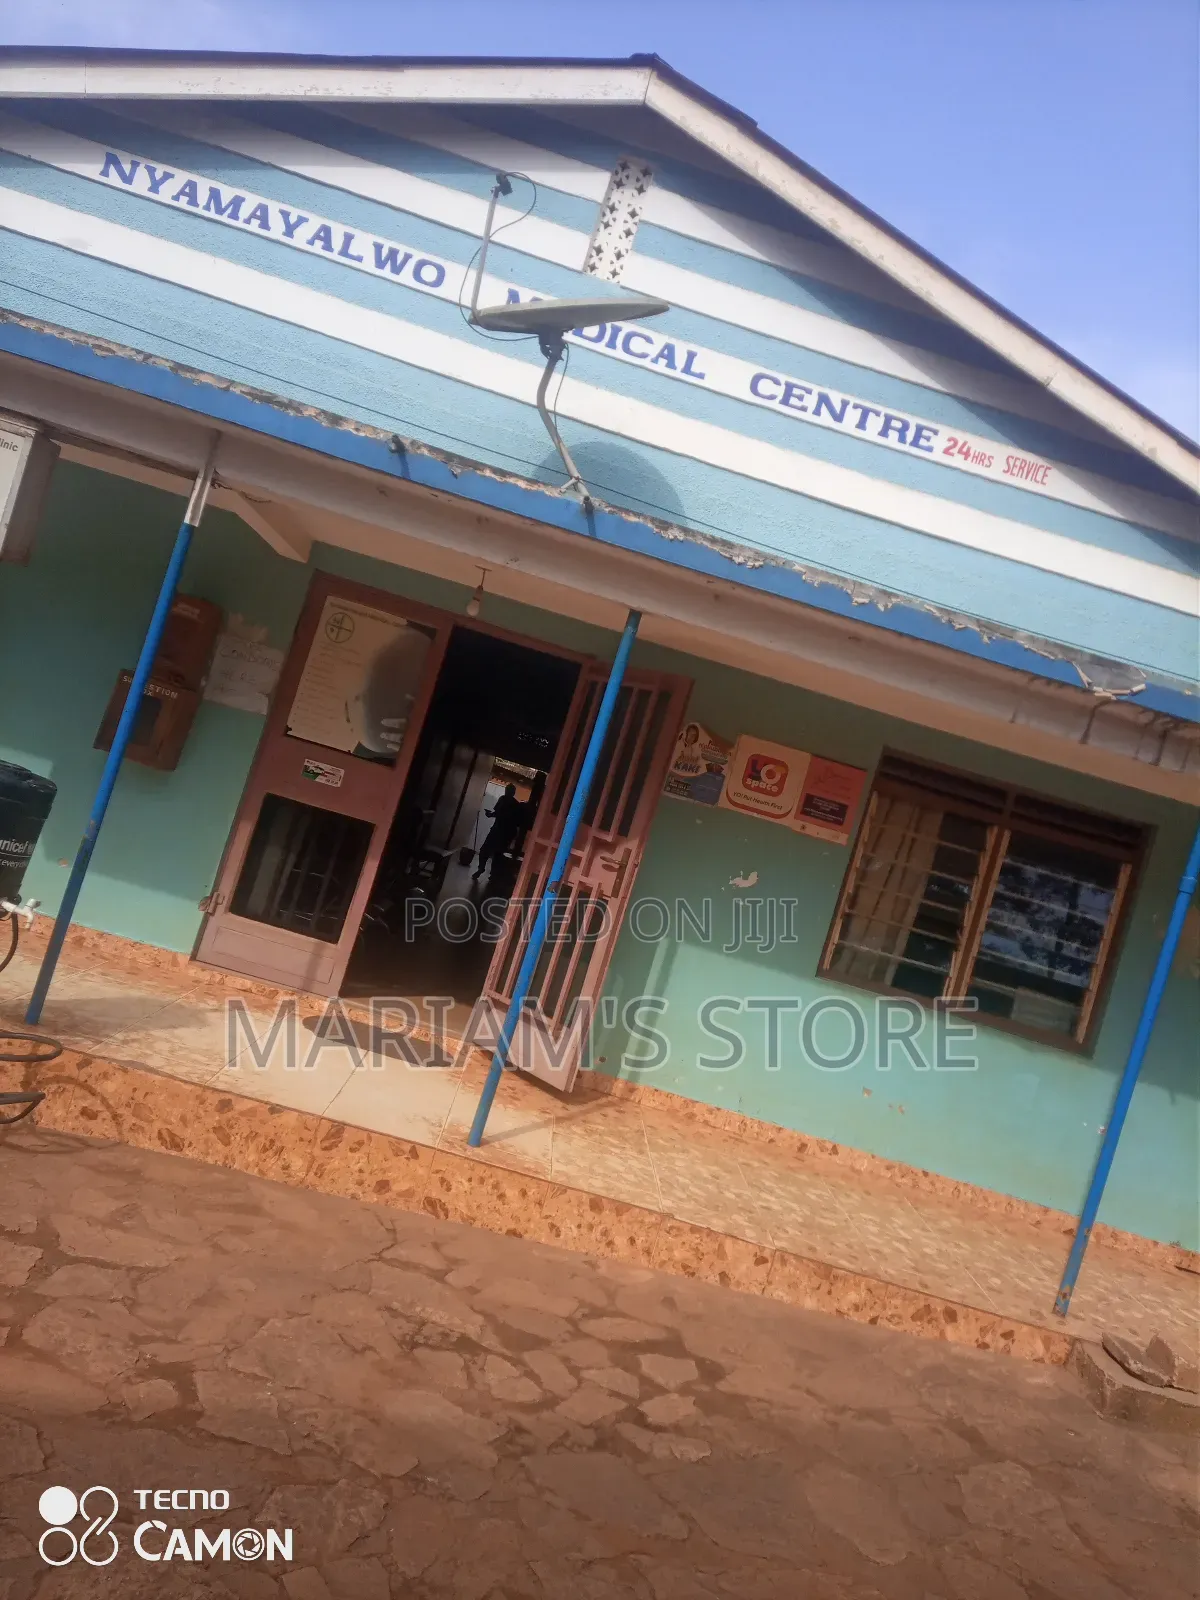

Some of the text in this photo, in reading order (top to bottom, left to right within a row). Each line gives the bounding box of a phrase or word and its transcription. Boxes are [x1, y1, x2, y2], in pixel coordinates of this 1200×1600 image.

[98, 151, 446, 289] NYAMAYALWO
[506, 287, 706, 380] DICAL
[749, 371, 939, 453] CENTRE
[1002, 455, 1053, 486] SERVICE
[123, 675, 179, 699] SUSTION
